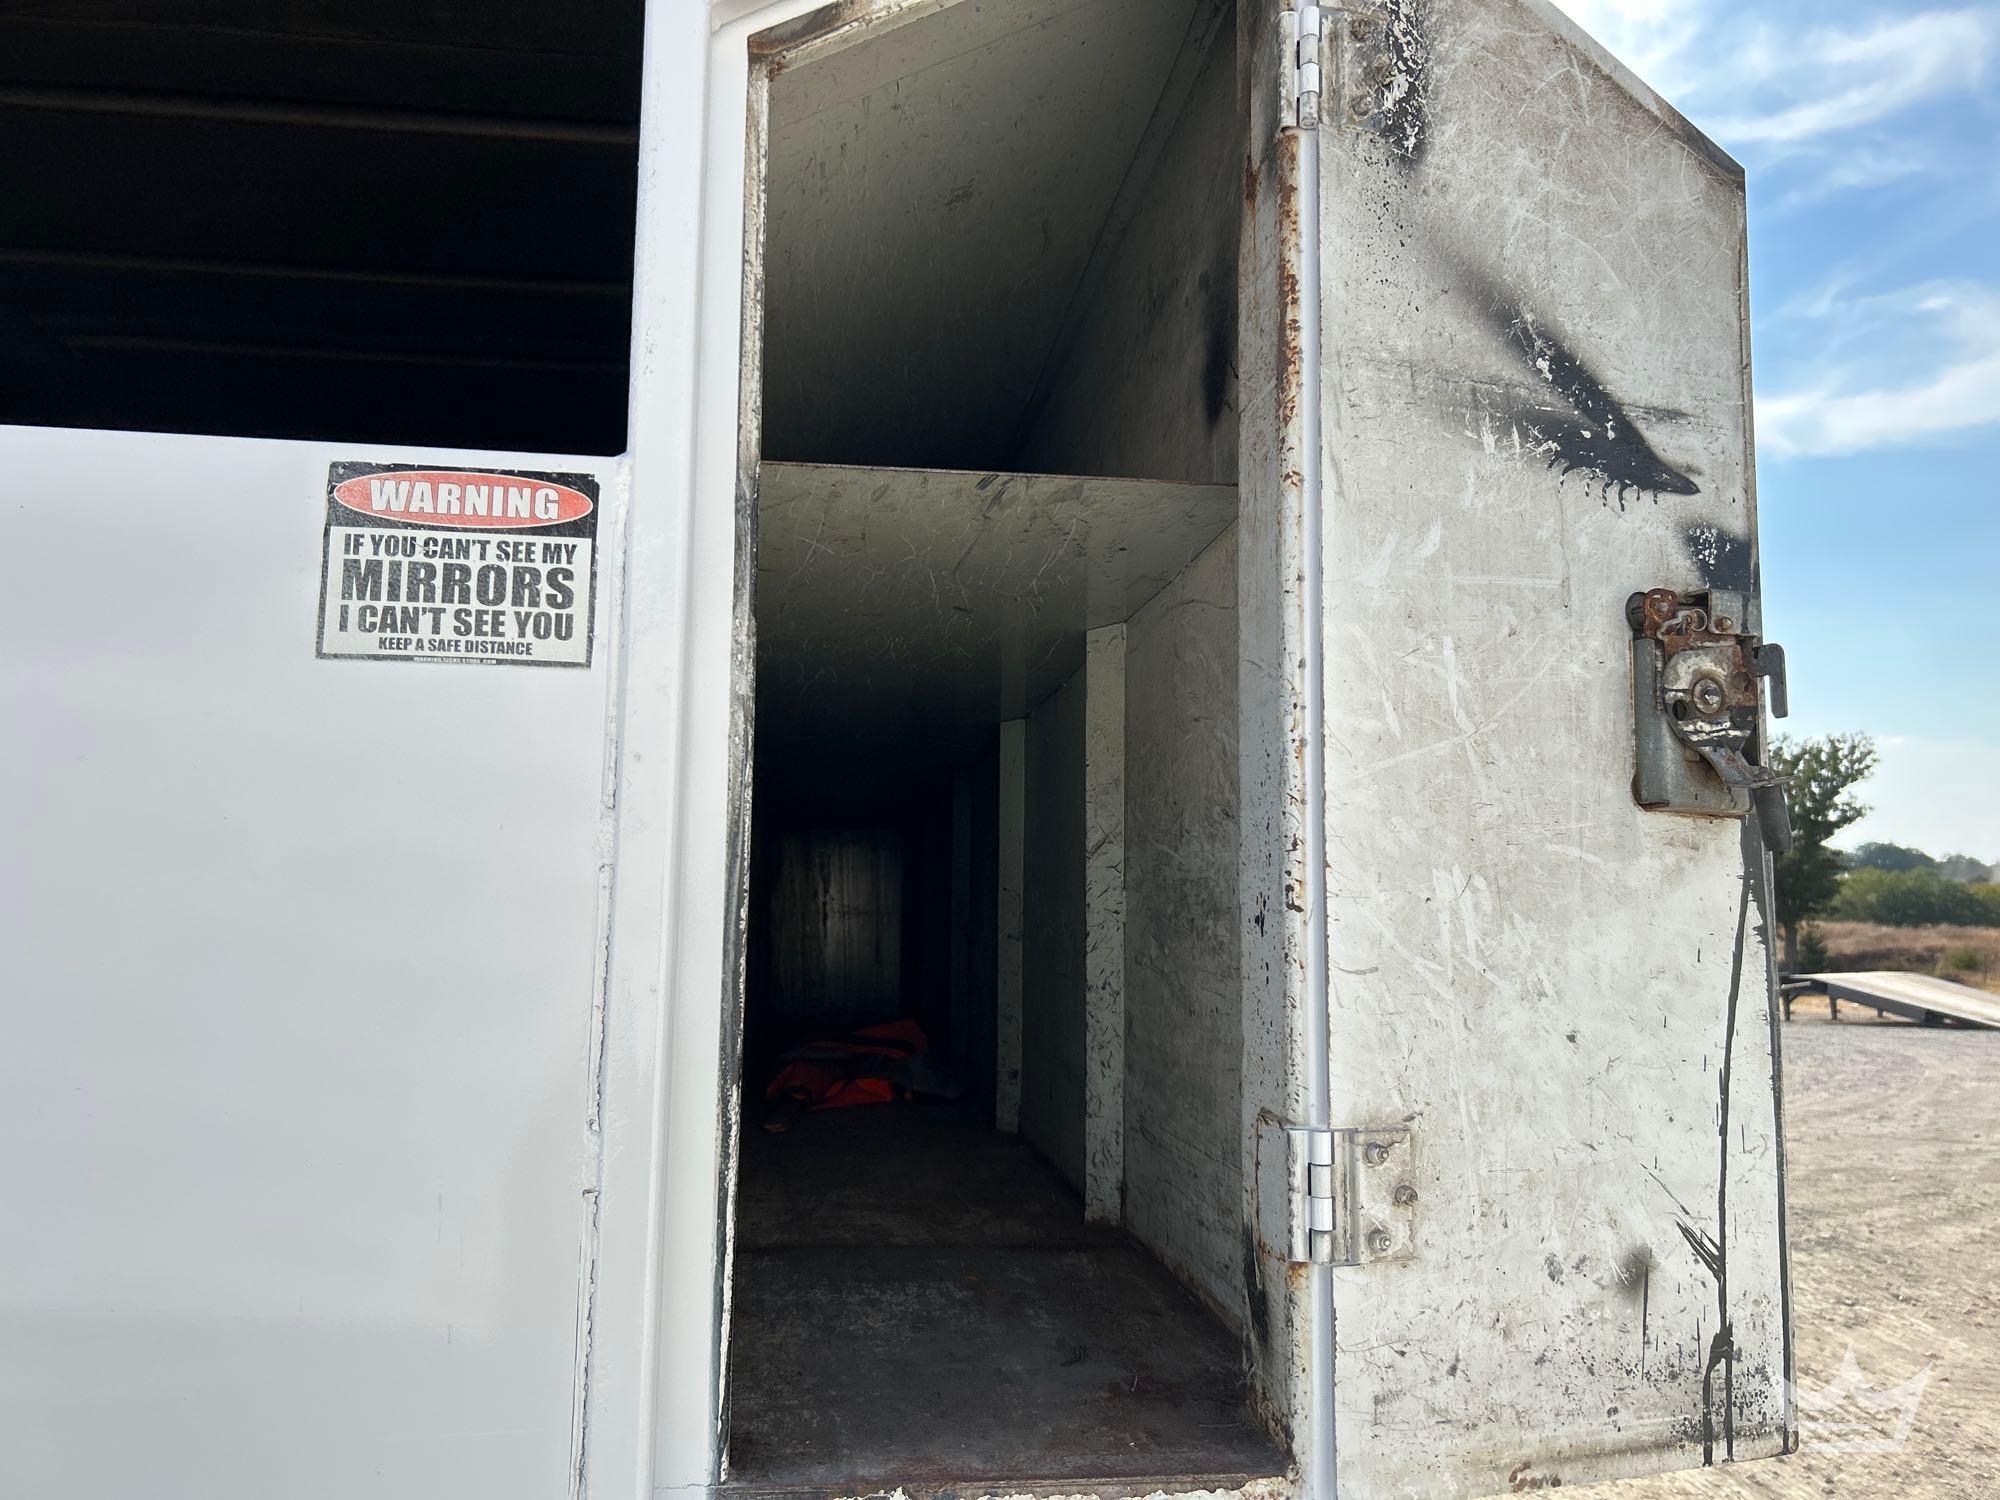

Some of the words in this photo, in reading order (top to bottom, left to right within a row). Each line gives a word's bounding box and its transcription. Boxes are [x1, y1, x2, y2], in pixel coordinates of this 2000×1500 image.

[370, 480, 559, 520] WARNING
[344, 533, 365, 555] IF
[370, 535, 417, 557] YOU
[423, 537, 490, 561] CAN'T
[496, 541, 536, 563] SEE
[542, 543, 577, 565] MY
[341, 559, 574, 609] MIRRORS
[339, 604, 349, 632] I
[357, 605, 446, 635] CAN'T
[453, 608, 505, 637] SEE
[514, 611, 574, 641] YOU
[379, 637, 412, 651] KEEP
[415, 638, 425, 651] A
[428, 639, 461, 653] SAFE
[465, 640, 533, 655] DISTANCE
